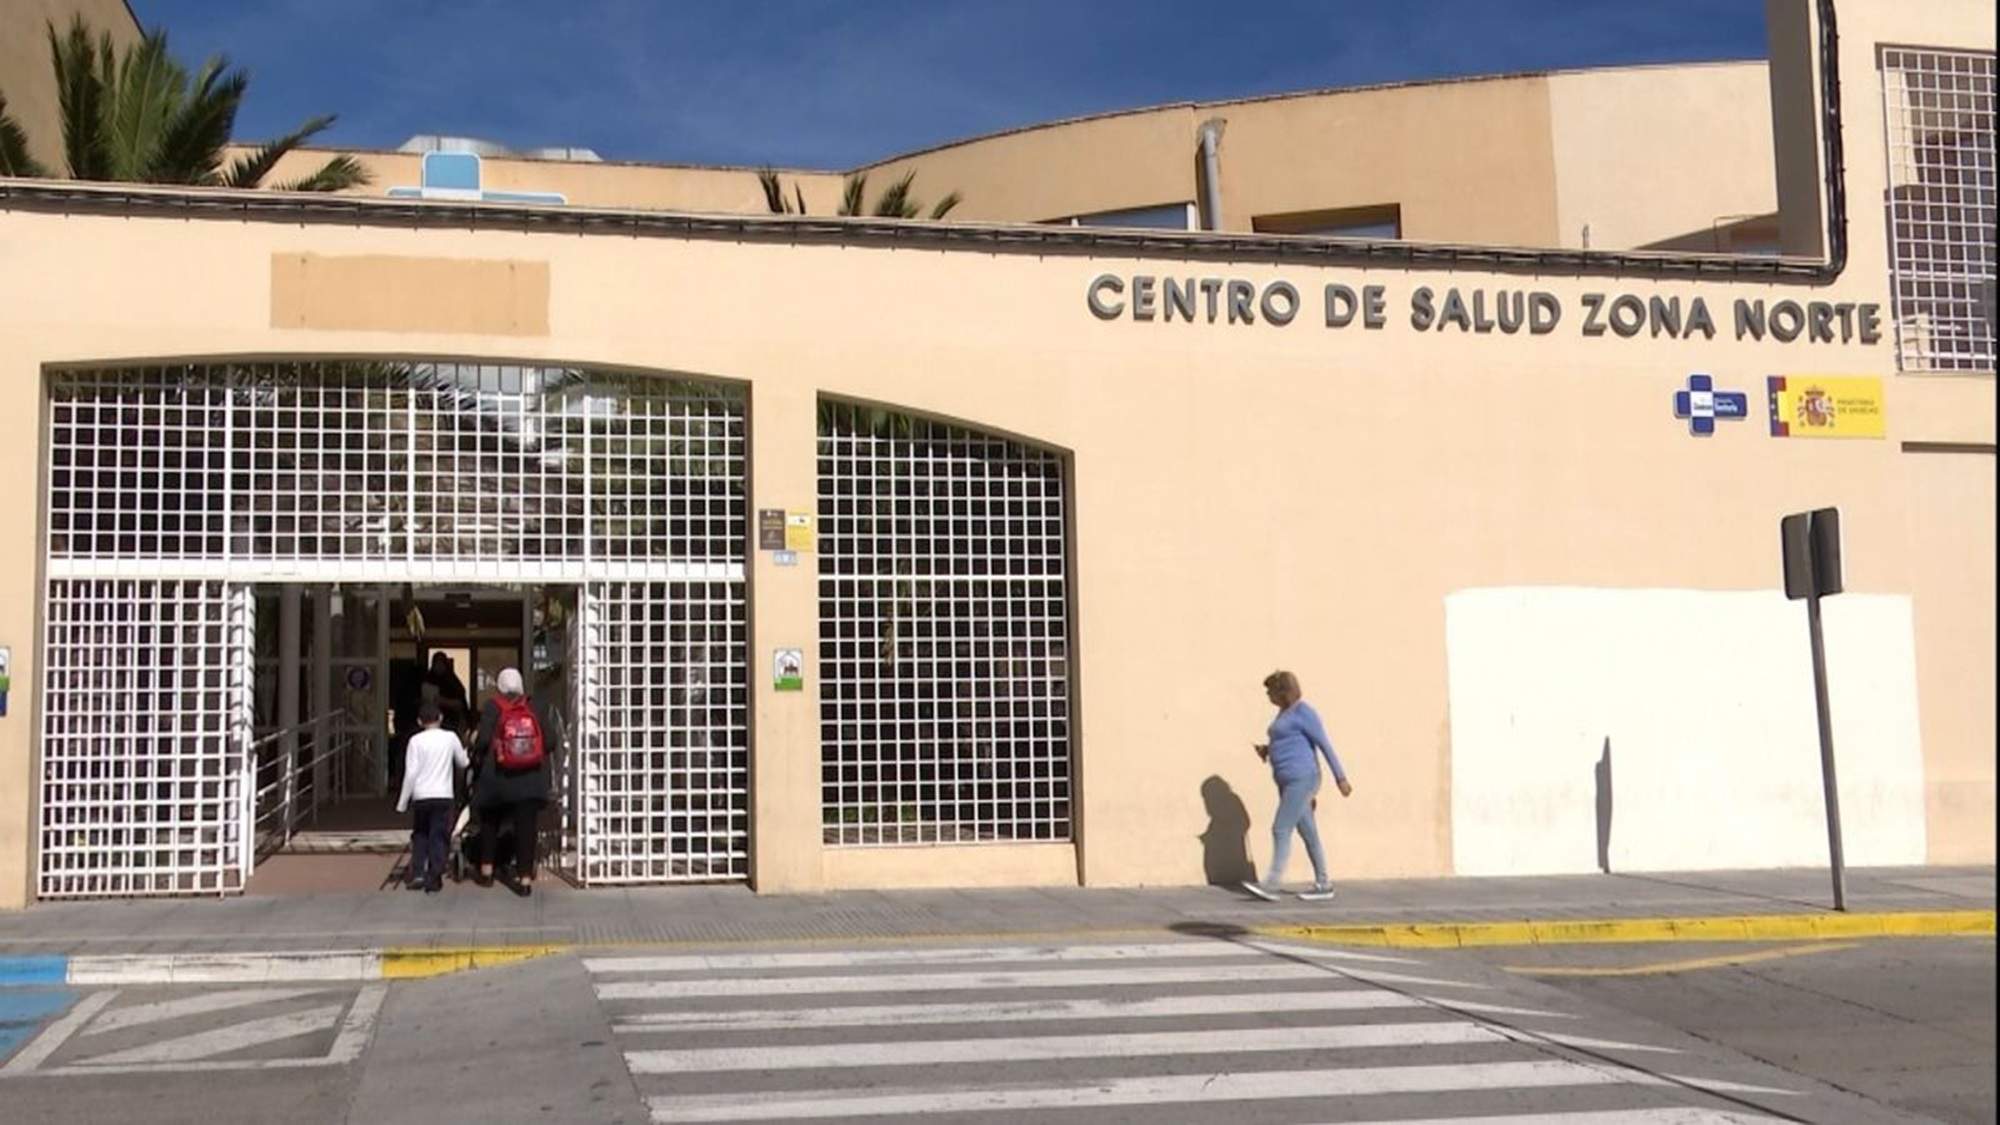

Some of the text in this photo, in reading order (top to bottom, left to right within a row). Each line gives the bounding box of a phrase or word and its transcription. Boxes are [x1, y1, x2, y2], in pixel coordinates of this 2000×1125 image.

[1087, 273, 1883, 346] CENTRO DE SALUD ZONA NORTE
